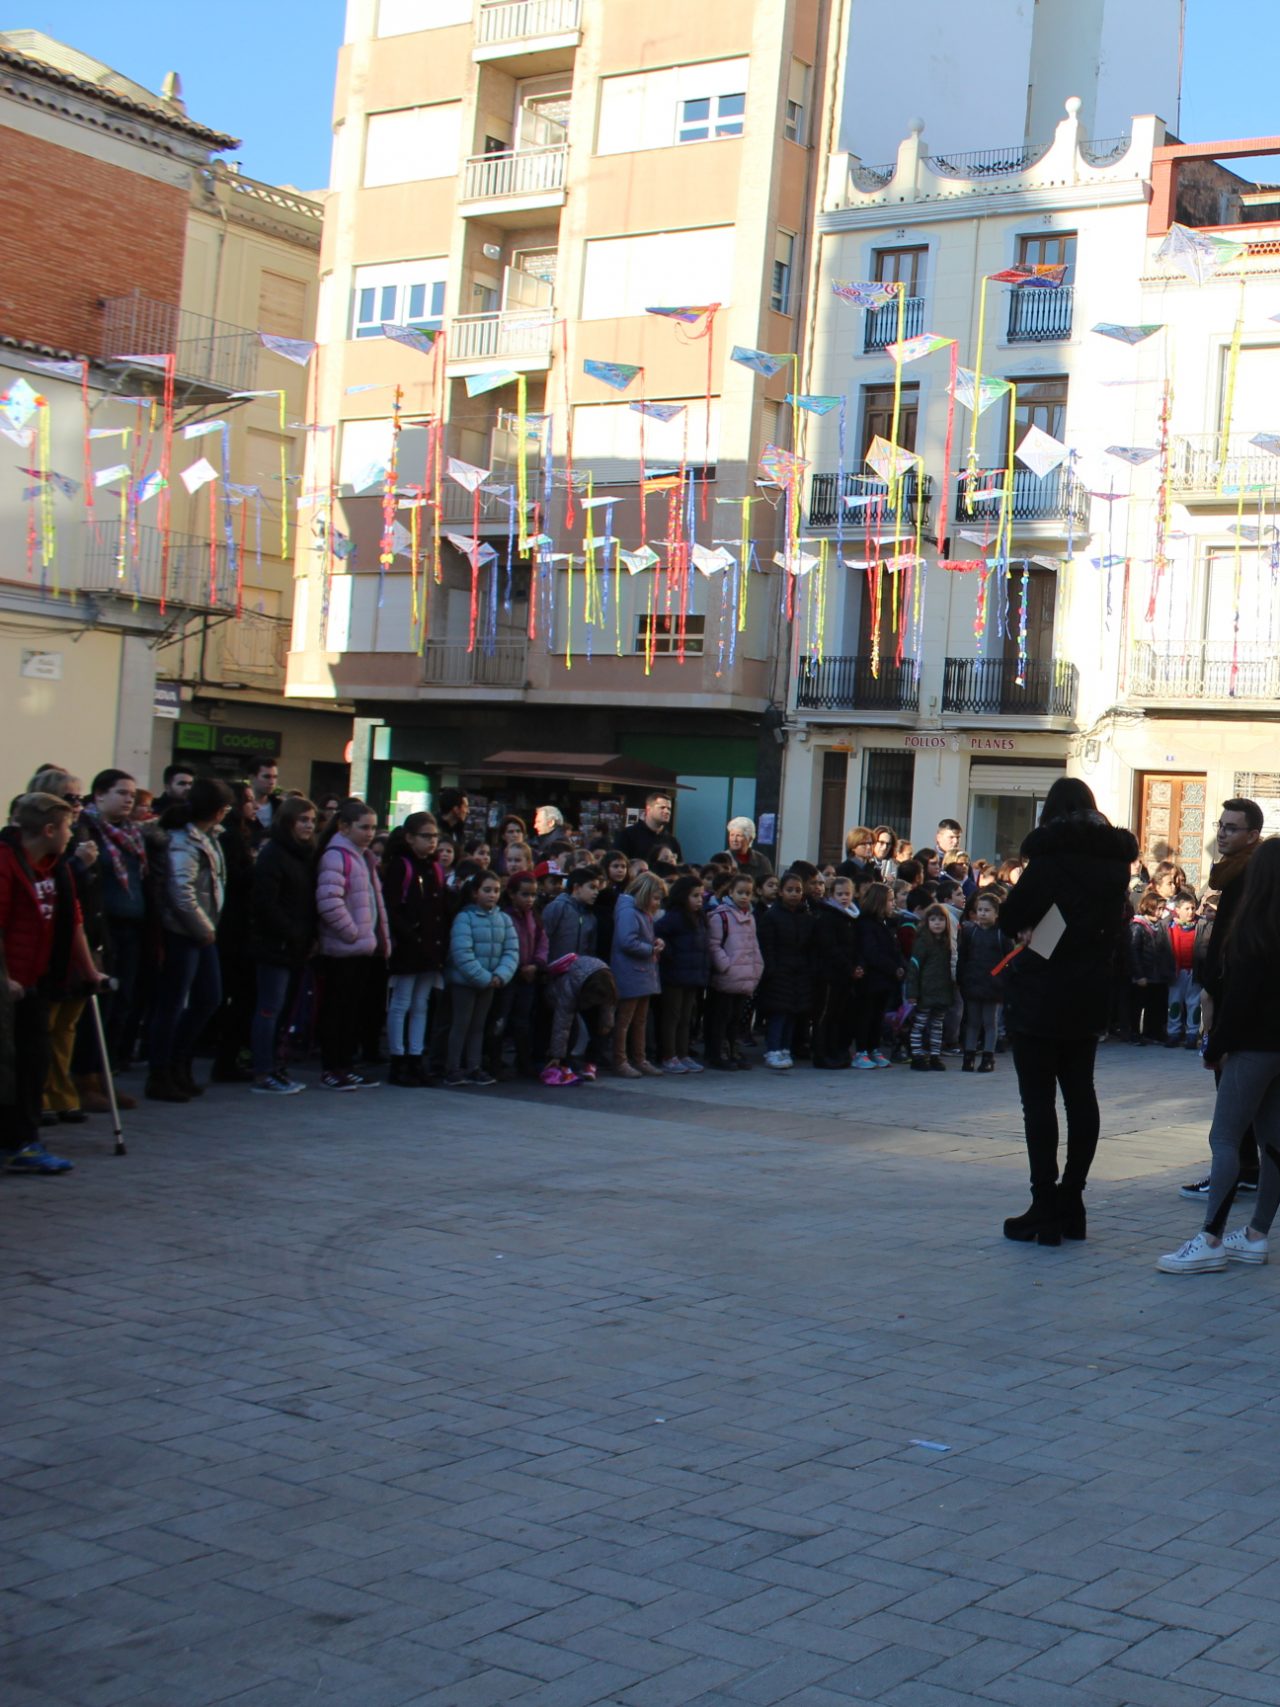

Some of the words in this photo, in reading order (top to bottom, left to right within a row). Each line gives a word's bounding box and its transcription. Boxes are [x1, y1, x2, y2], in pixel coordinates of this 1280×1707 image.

[222, 734, 276, 750] codere
[904, 736, 946, 748] POLLOS
[970, 738, 1015, 750] PLANES
